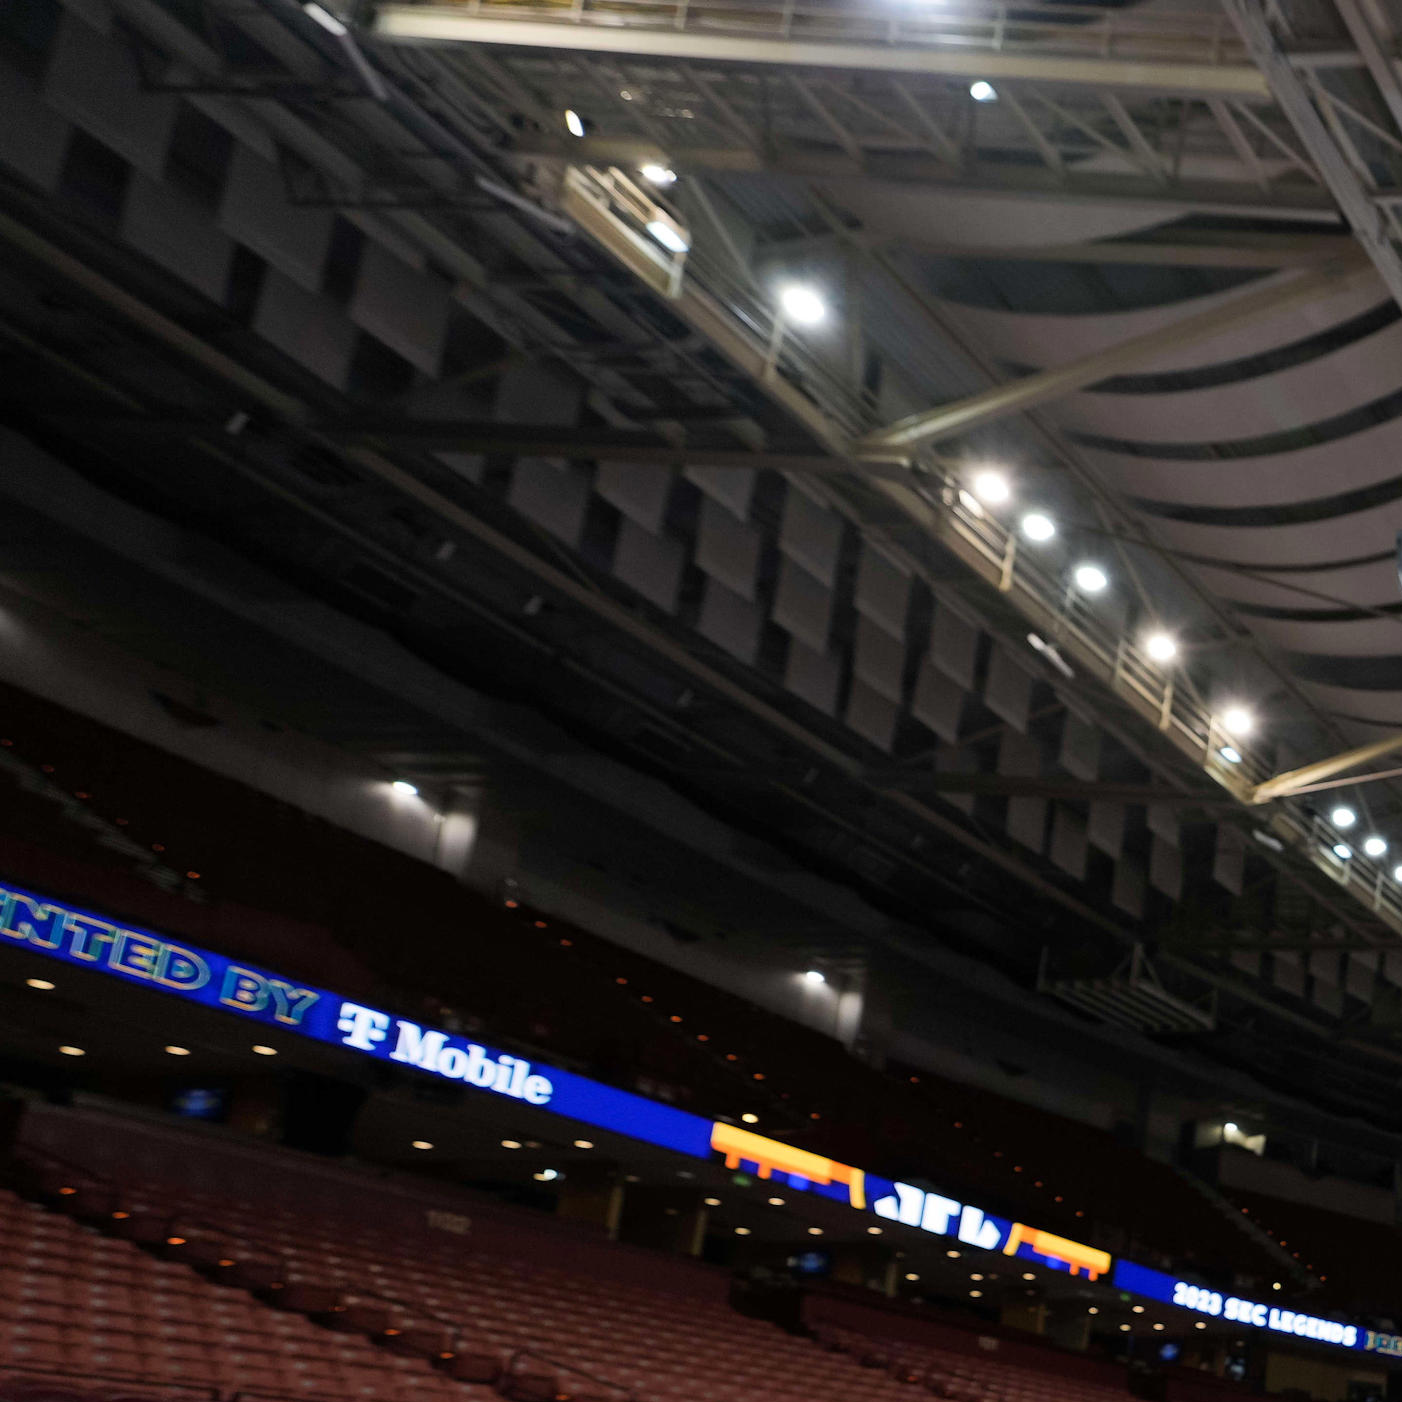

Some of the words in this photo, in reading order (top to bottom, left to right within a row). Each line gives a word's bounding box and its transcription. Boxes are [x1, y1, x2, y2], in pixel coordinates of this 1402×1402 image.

[0, 887, 211, 991] NTED
[218, 964, 320, 1025] BY
[336, 1001, 391, 1051] T
[389, 1019, 553, 1105] Mobile
[1172, 1281, 1223, 1317] 2023
[1223, 1296, 1269, 1328] SEC
[1267, 1307, 1358, 1347] LEGENDS
